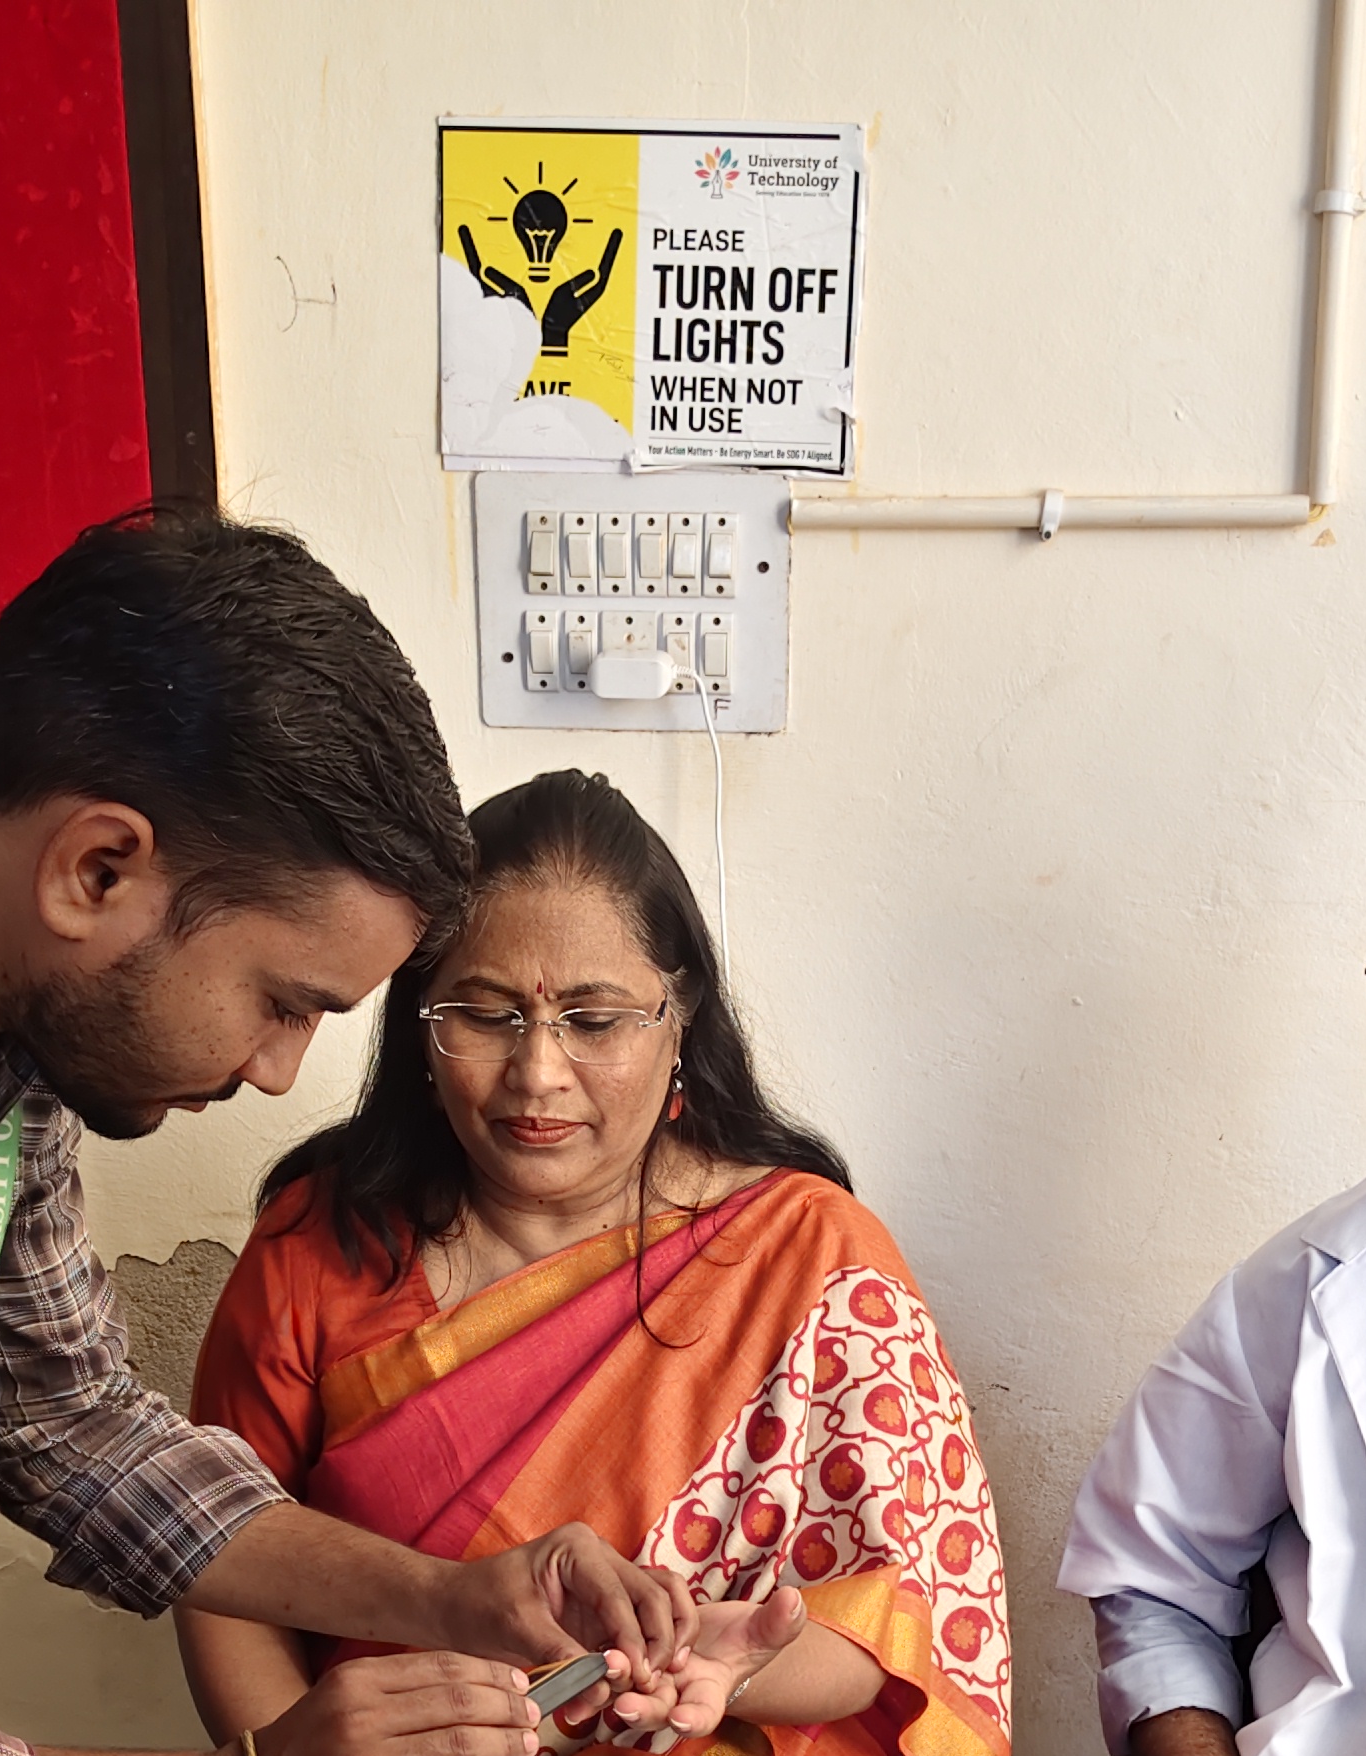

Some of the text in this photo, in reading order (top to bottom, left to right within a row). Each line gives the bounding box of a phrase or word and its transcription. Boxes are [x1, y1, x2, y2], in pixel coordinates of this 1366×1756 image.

[749, 155, 838, 171] University of
[748, 172, 839, 191] Technology
[654, 228, 744, 252] PLEASE
[653, 264, 837, 313] TURN OFF
[653, 318, 784, 365] LIGHTS
[651, 376, 803, 405] WHEN NOT
[651, 406, 743, 433] IN USE
[649, 445, 663, 454] Your
[665, 446, 685, 455] Action
[687, 447, 713, 456] Matters
[720, 447, 727, 456] Be
[730, 448, 751, 459] Energy
[753, 449, 774, 458] Smart.
[777, 449, 785, 458] Be
[787, 450, 799, 459] SDG
[807, 451, 833, 462] Aligned.
